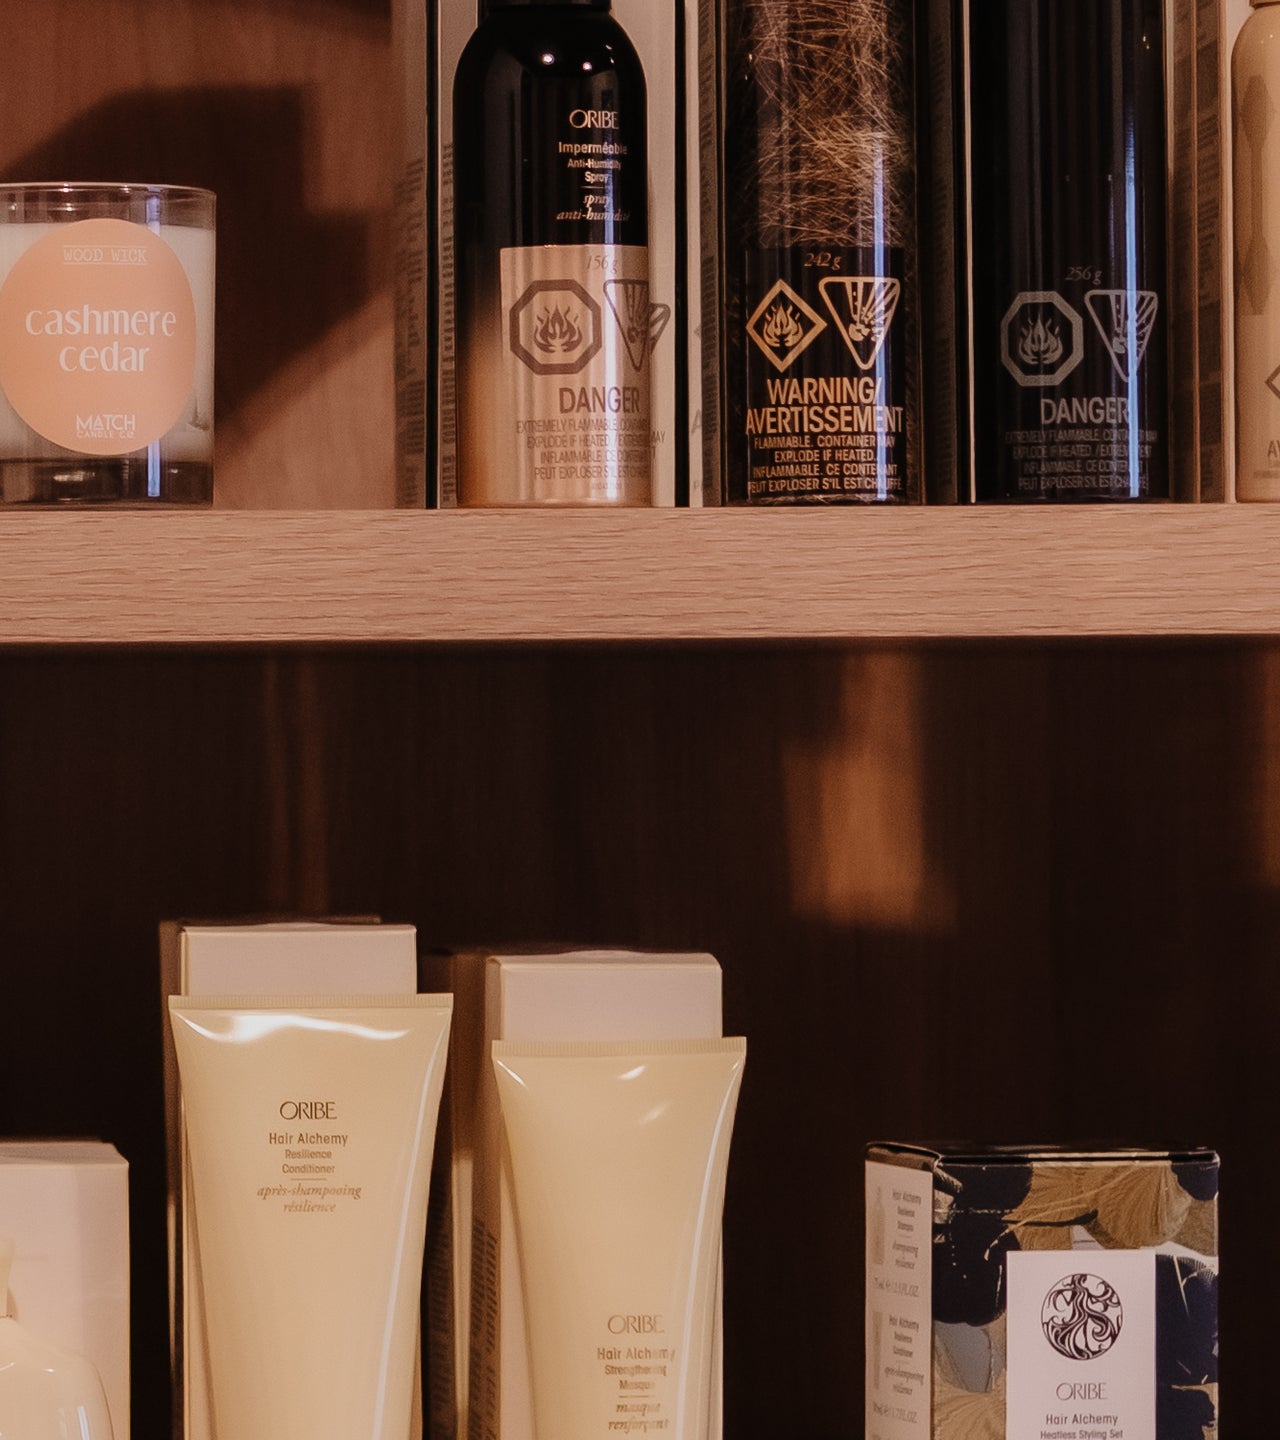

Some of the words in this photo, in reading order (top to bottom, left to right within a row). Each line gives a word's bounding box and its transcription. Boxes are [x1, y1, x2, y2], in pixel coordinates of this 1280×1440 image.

[569, 109, 620, 129] ORIBE
[558, 141, 628, 156] Imperméable
[584, 170, 609, 183] Spray
[62, 248, 104, 262] WOOD
[111, 248, 148, 263] WICK
[25, 304, 177, 337] cashmere
[58, 341, 150, 372] cedar
[766, 377, 883, 405] WARNING/
[558, 386, 641, 414] DANGER
[1040, 396, 1130, 424] DANGER
[75, 414, 136, 431] MATCH
[745, 405, 904, 436] AVERTISSEMENT
[774, 449, 820, 463] EXPLODE
[822, 449, 833, 462] IF
[835, 448, 876, 463] HEATED.
[280, 1100, 338, 1120] ORIBE
[269, 1132, 294, 1145] Hair
[297, 1132, 349, 1148] Alchemy
[284, 1149, 332, 1160] Resilience
[282, 1163, 336, 1174] Conditioner
[257, 1183, 362, 1201] après-shampooing
[283, 1199, 337, 1214] résilience
[607, 1314, 665, 1335] ORIBE
[597, 1347, 622, 1360] Hair
[1056, 1382, 1109, 1401] ORIBE
[1045, 1414, 1068, 1426] Hair
[1071, 1413, 1119, 1426] Alchemy
[1040, 1431, 1077, 1440] Heatless
[1078, 1430, 1108, 1440] Styling
[1109, 1428, 1124, 1440] Set
